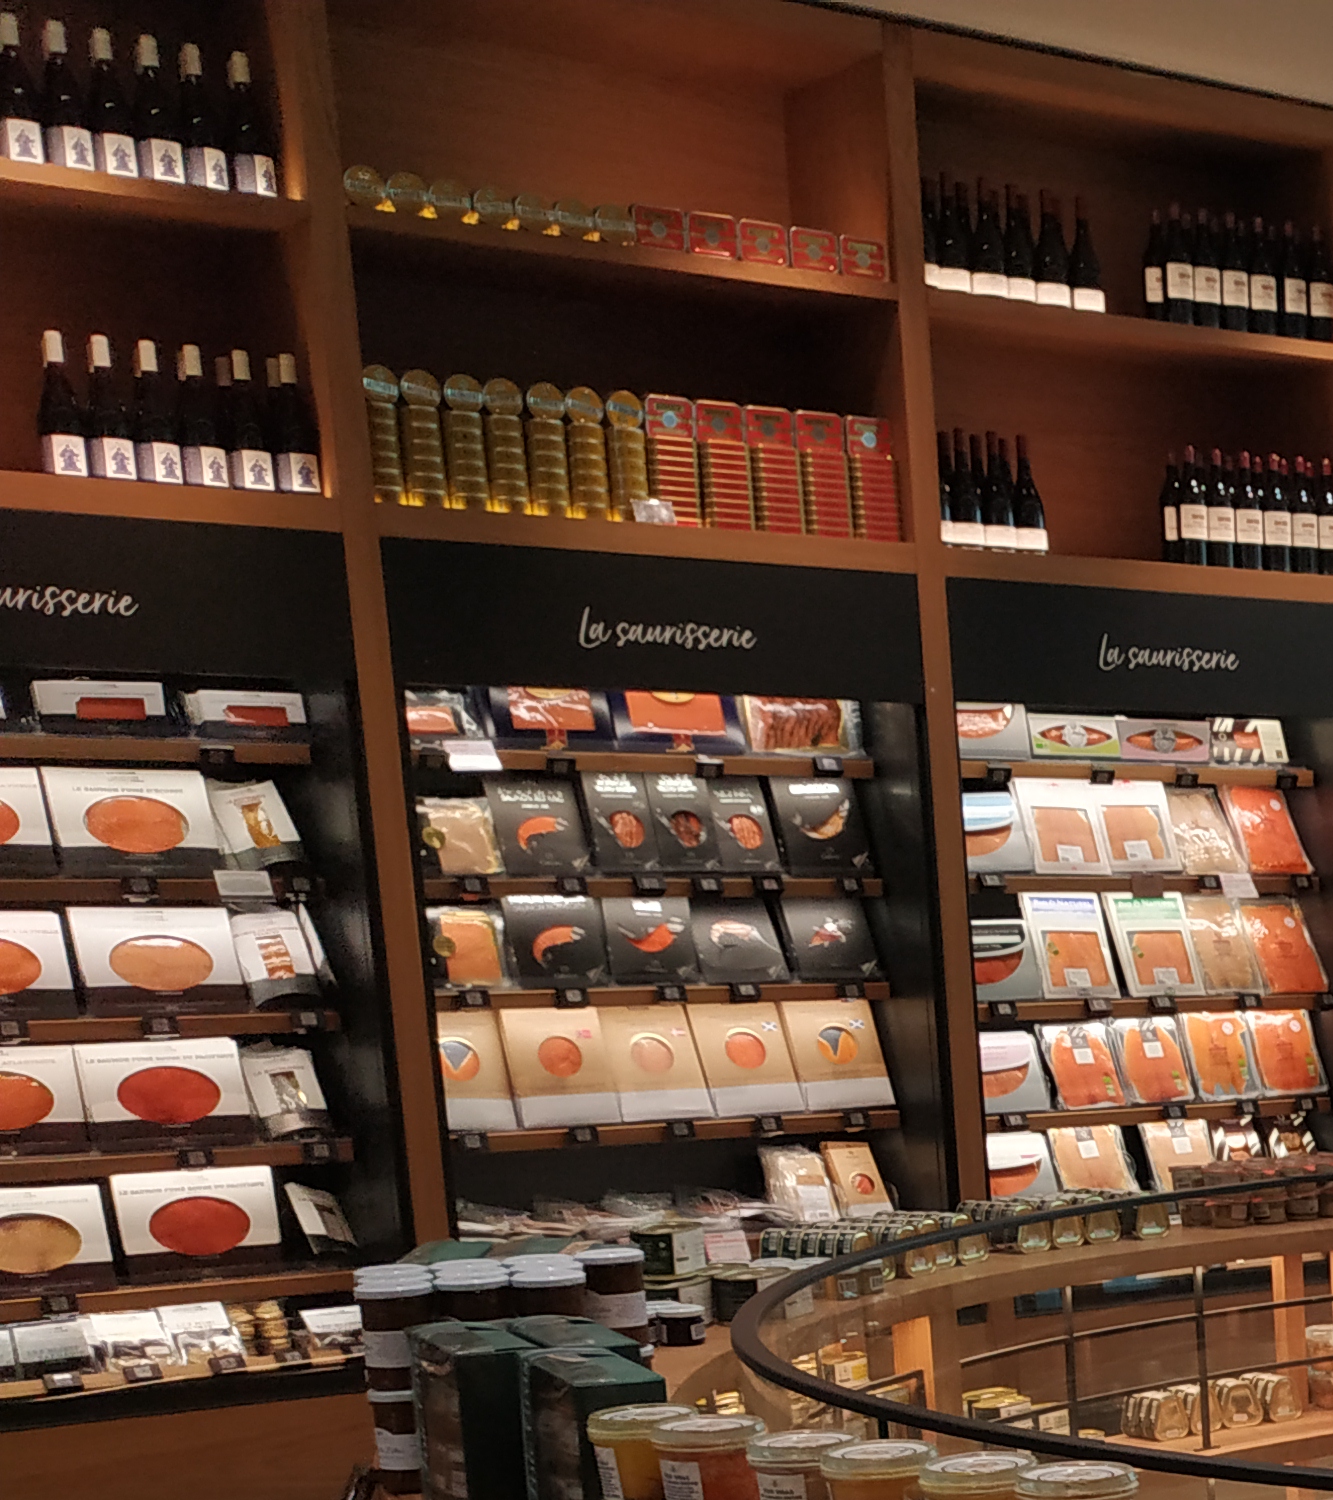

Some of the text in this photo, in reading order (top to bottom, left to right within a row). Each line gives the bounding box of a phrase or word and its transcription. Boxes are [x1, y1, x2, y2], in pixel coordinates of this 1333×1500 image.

[0, 586, 139, 616] urisserie
[578, 605, 757, 650] La saurisserie
[1099, 633, 1239, 672] La saurisserie
